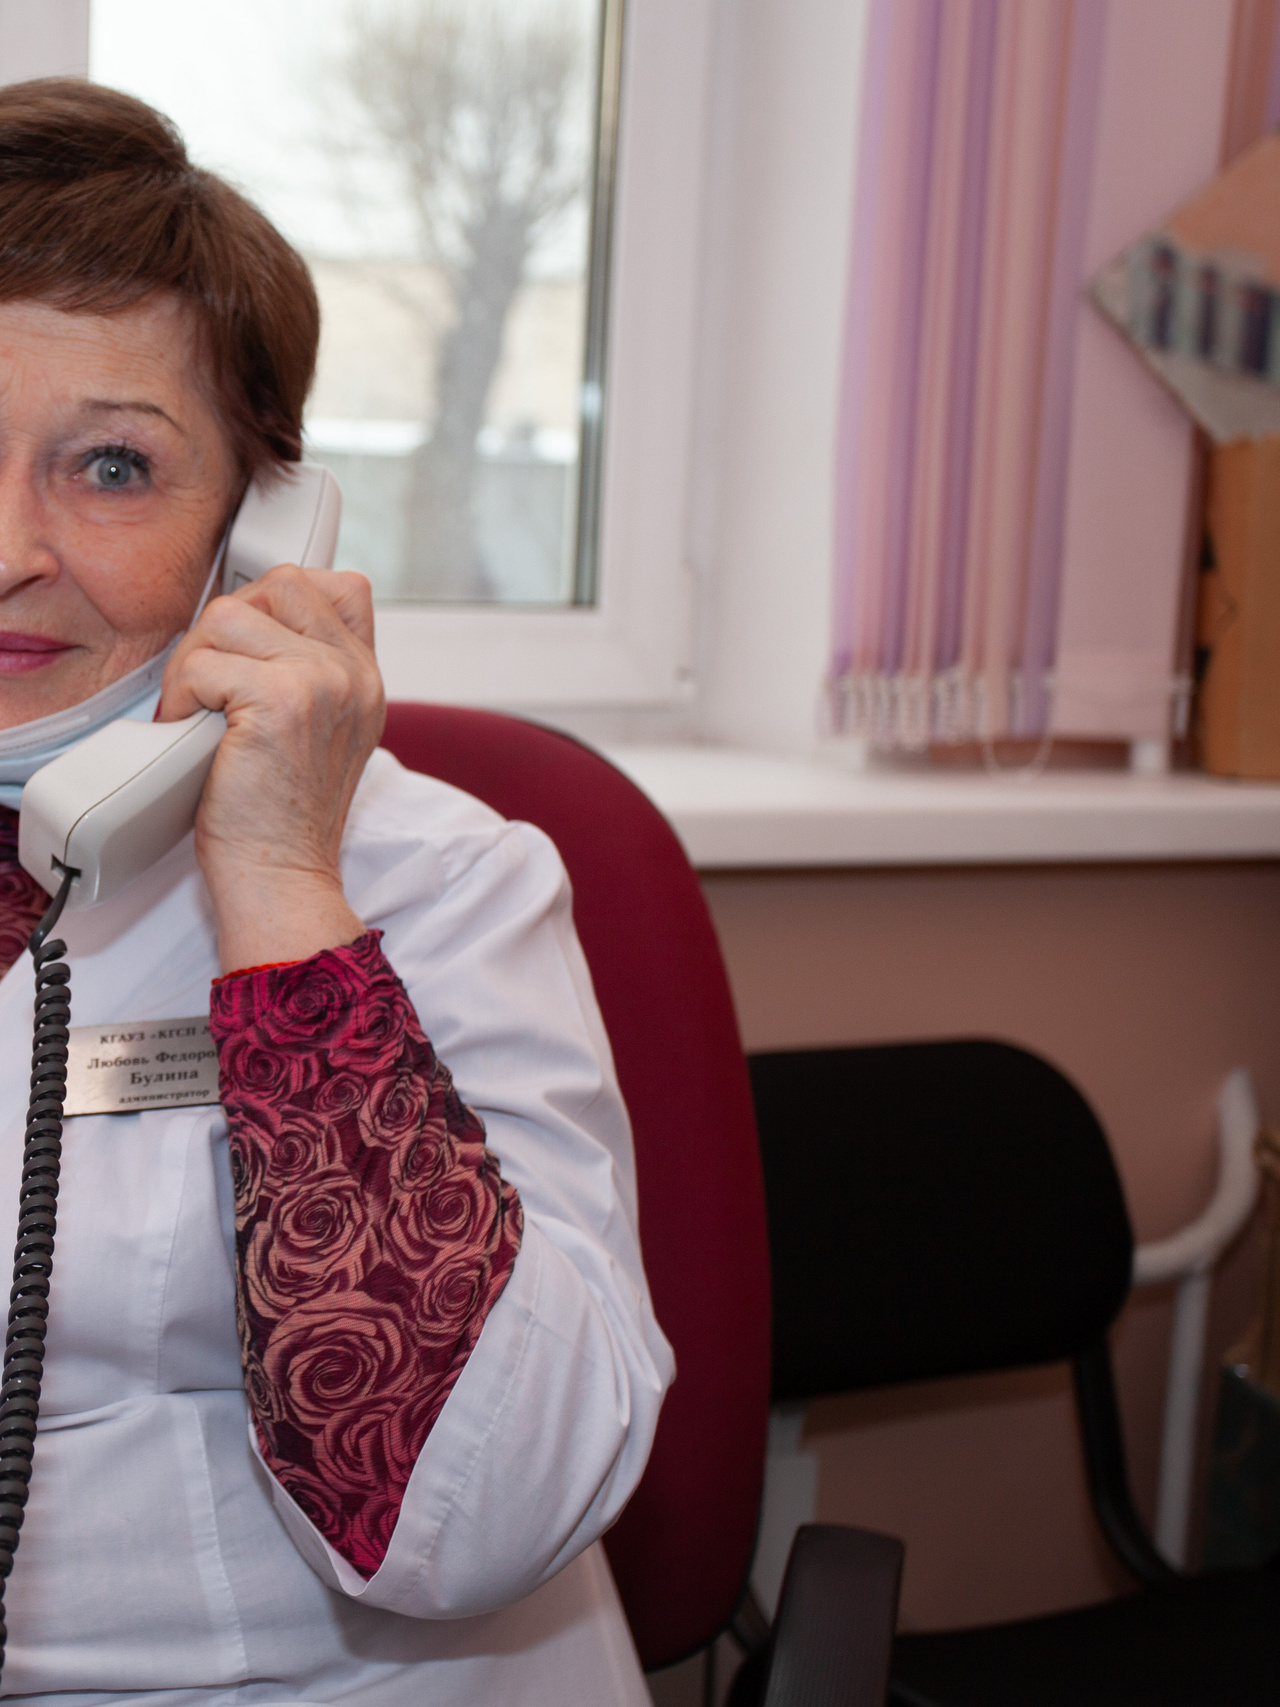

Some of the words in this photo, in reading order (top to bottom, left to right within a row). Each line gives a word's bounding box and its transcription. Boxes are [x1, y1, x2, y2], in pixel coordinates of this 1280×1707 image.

[100, 1031, 145, 1045] КГАУЗ
[87, 1056, 149, 1070] Любовь
[155, 1050, 218, 1066] Федоро
[130, 1070, 199, 1087] Булина
